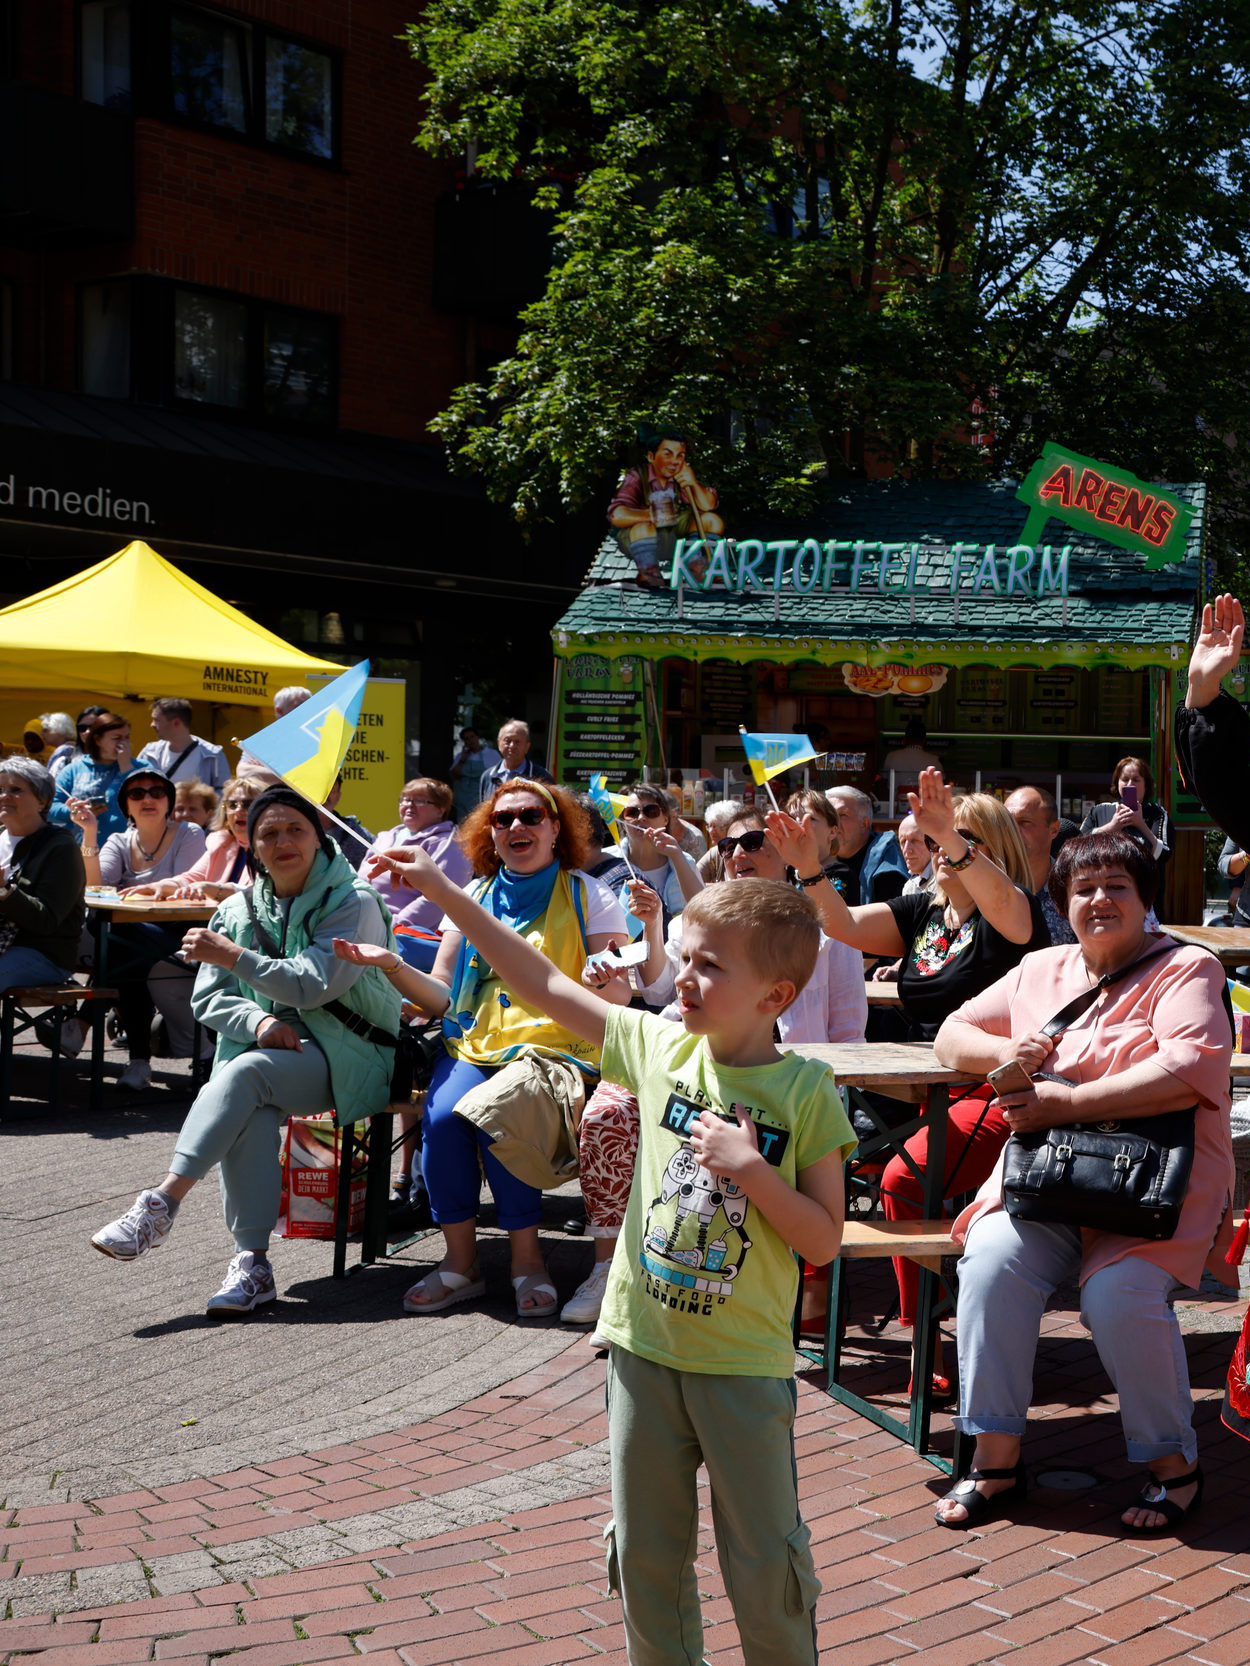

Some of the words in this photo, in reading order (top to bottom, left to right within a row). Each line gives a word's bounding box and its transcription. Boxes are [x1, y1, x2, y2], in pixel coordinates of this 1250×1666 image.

[28, 486, 156, 525] medien.
[1039, 464, 1177, 546] ARENS
[671, 538, 930, 594] KARTOFFEL
[949, 541, 1072, 597] FARM
[203, 666, 269, 685] AMNESTY
[203, 682, 268, 697] INTERNATIONAL
[346, 749, 390, 763] SCHEN-
[297, 1172, 329, 1181] REWE
[297, 1185, 311, 1193] DEIN
[311, 1185, 329, 1194] MARKT
[641, 1268, 671, 1293] FAST
[678, 1289, 726, 1305] FOOD
[645, 1282, 712, 1316] LOADING
